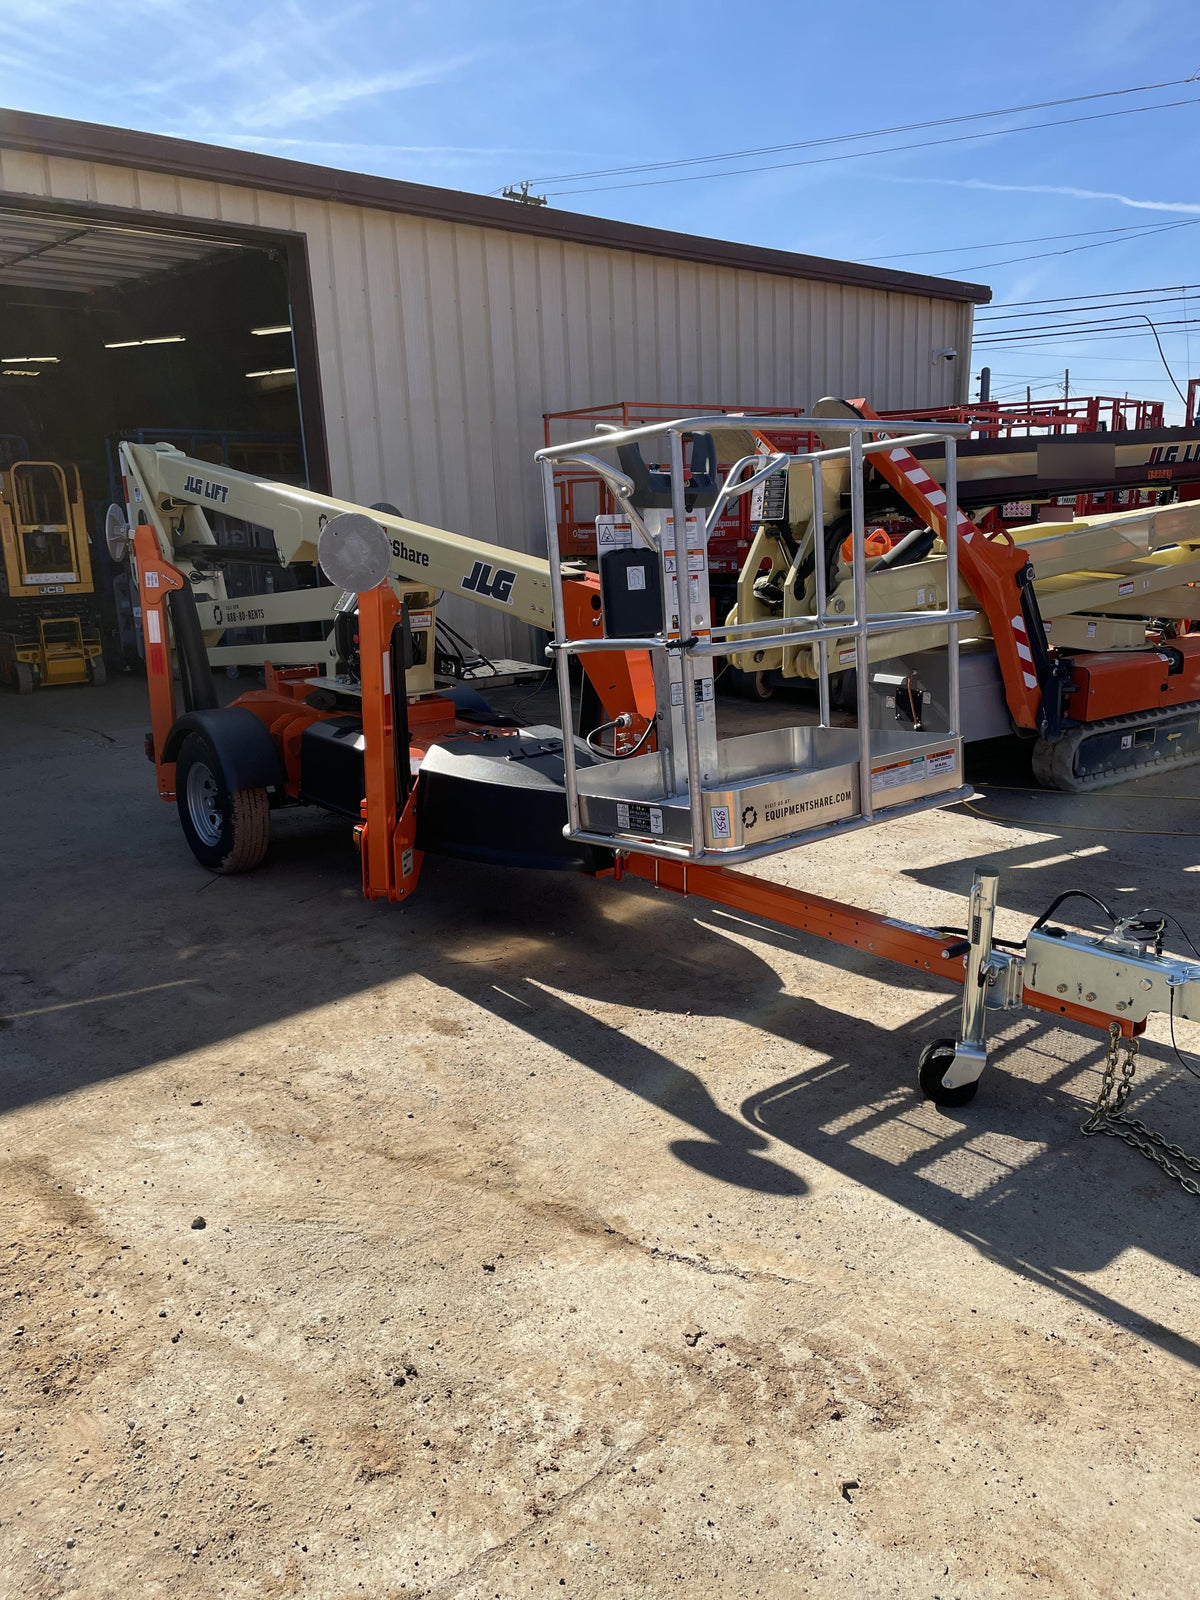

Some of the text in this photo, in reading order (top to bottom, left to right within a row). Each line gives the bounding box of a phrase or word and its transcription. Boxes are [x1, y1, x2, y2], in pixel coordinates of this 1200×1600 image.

[1144, 445, 1180, 465] JLG
[184, 475, 229, 504] JLG LIFT
[40, 586, 65, 594] JCB
[461, 560, 517, 604] JLG
[765, 802, 777, 810] VISIT
[765, 791, 851, 822] EQUIPMENTSHARE.COM
